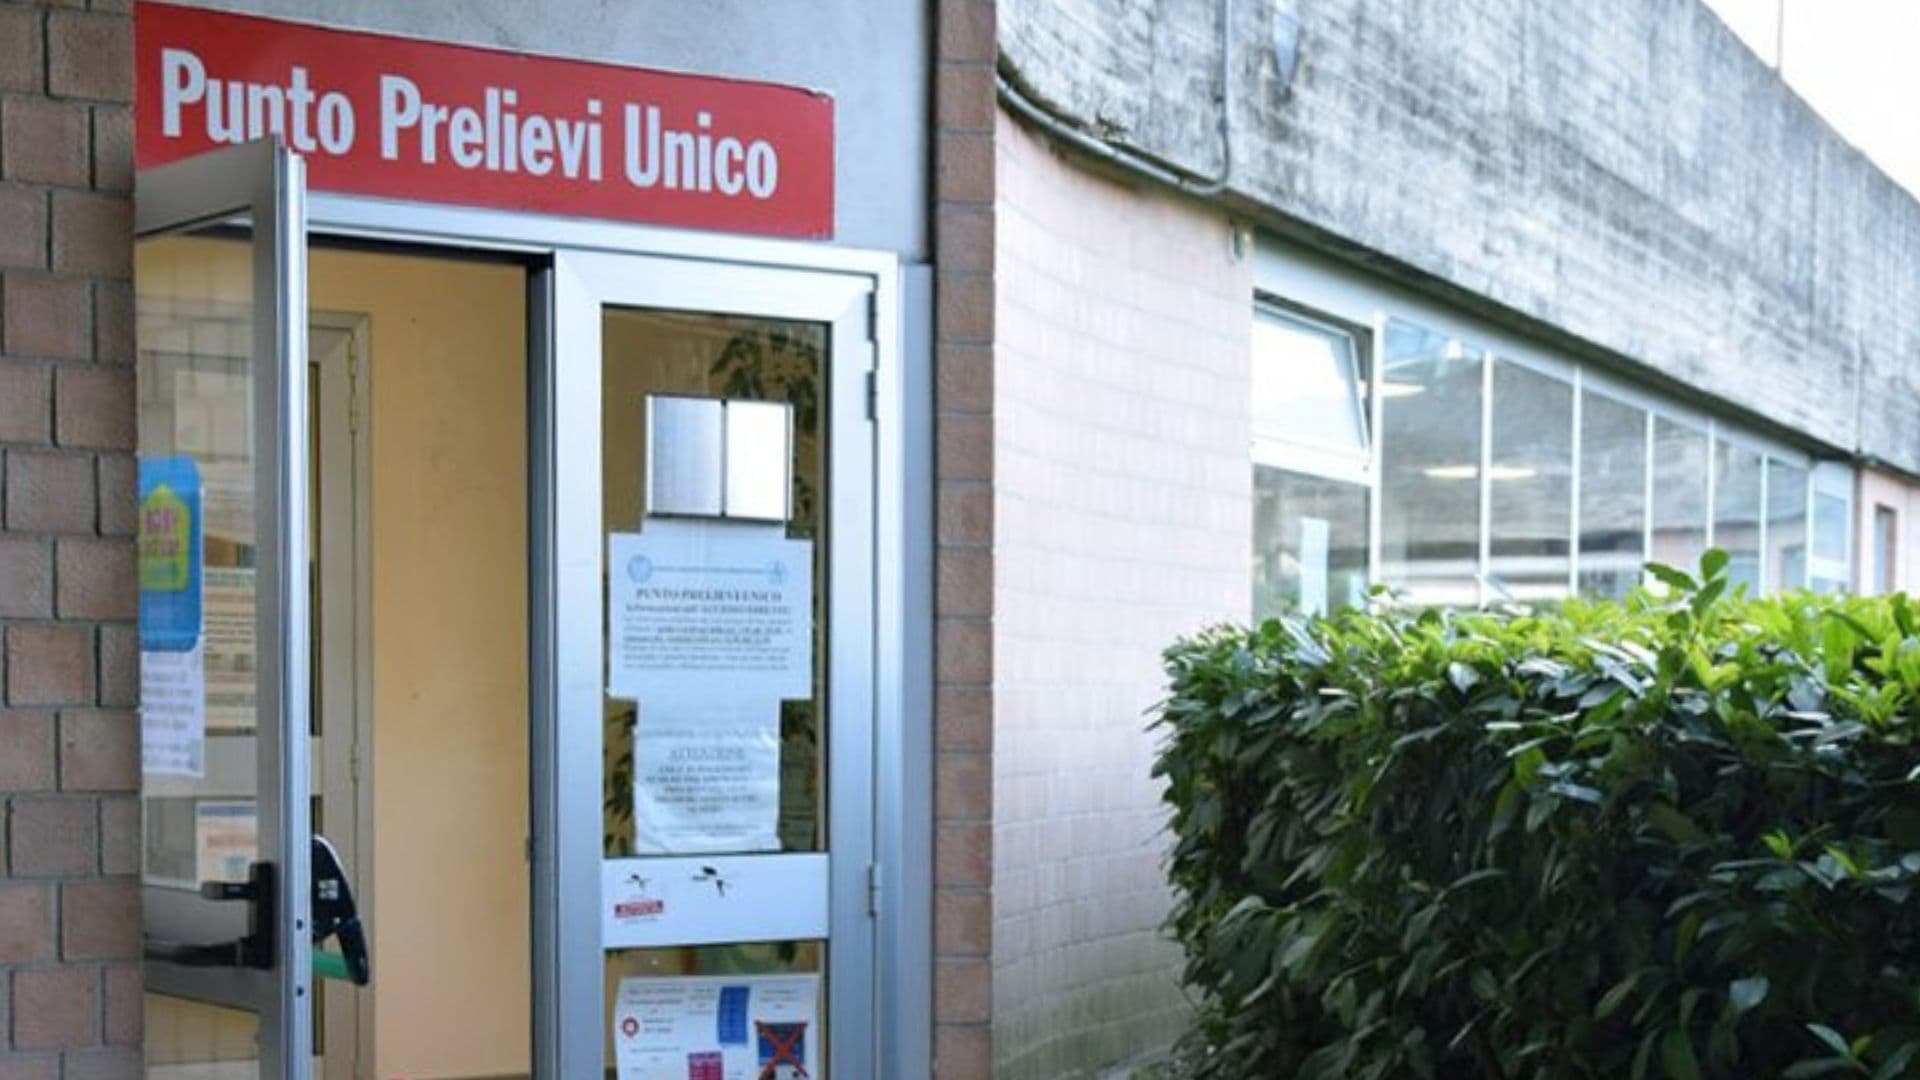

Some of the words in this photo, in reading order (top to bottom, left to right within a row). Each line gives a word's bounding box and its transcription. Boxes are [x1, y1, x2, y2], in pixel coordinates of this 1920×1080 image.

[161, 47, 355, 156] Punto
[380, 73, 602, 181] Prelievi
[624, 102, 778, 199] Unico
